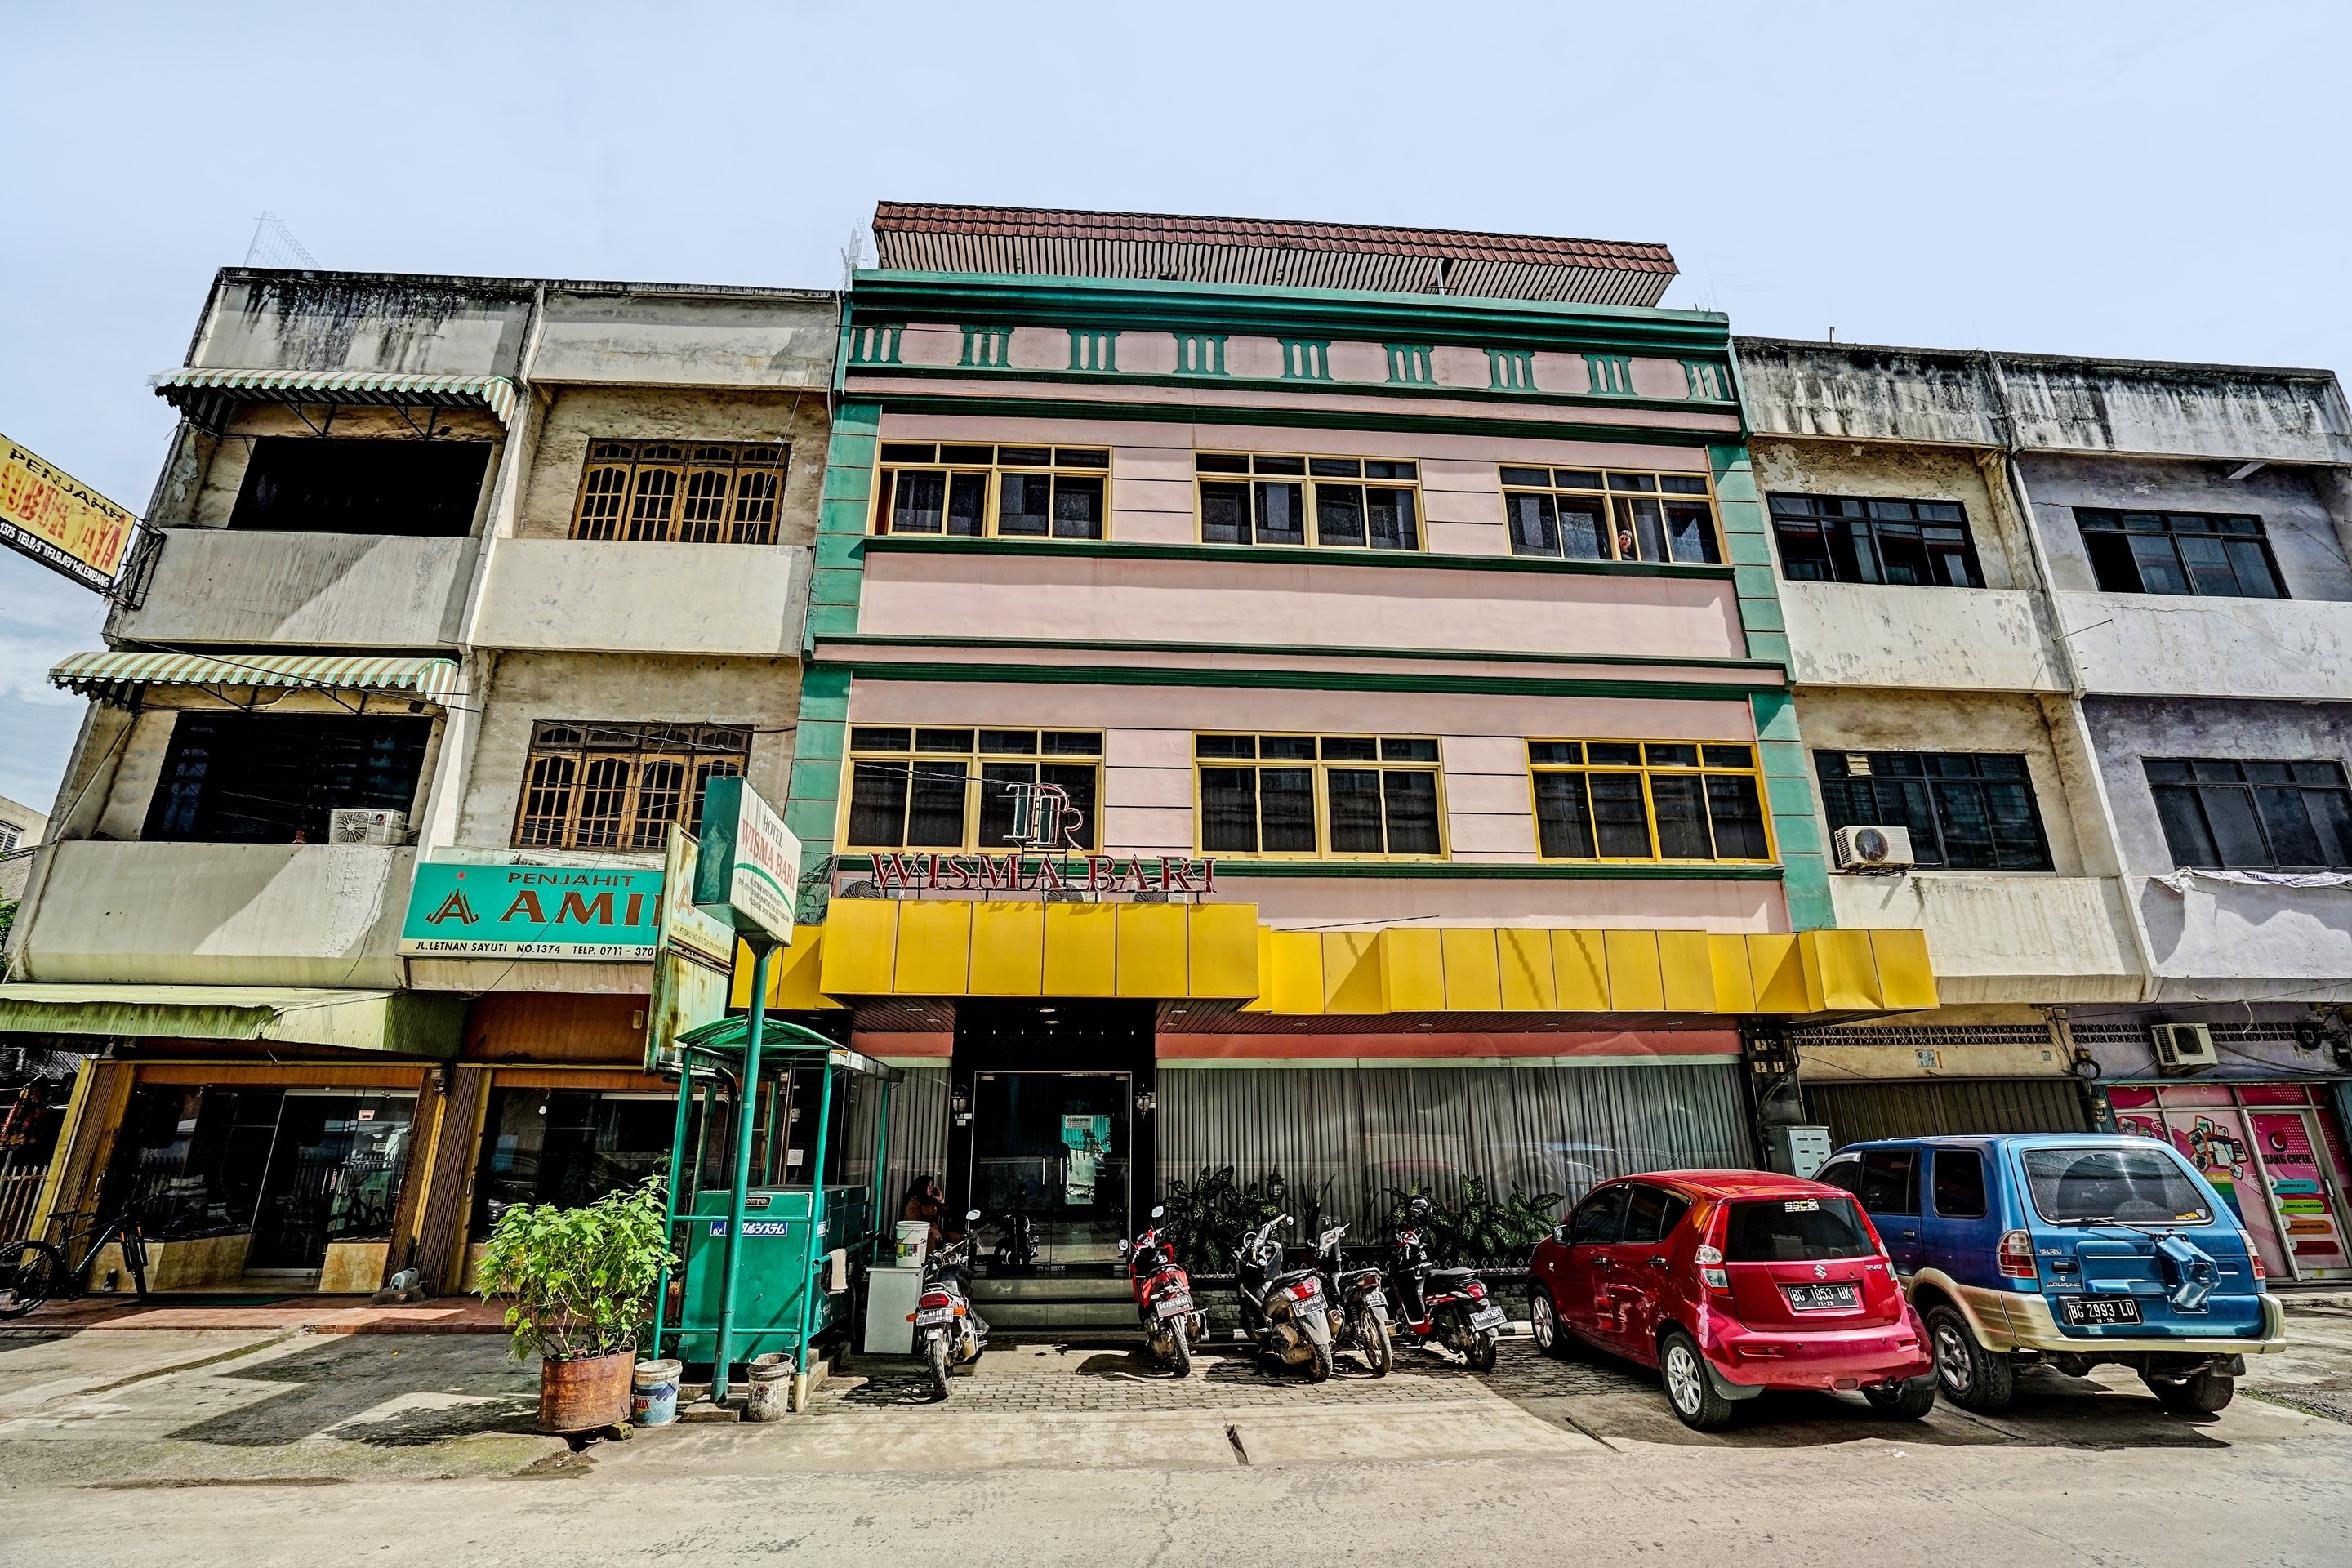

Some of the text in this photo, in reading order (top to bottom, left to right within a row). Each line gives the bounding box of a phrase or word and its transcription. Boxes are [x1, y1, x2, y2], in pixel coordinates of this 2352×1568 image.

[763, 814, 783, 849] HOTEL
[742, 818, 797, 891] WISMA BARI
[507, 872, 635, 887] PENJAHIT
[867, 851, 1218, 894] WISMA BARI
[497, 889, 662, 927] AMI
[471, 942, 507, 953] SAYUTI
[572, 945, 596, 955] TELP.
[2262, 1154, 2312, 1164] UANG CIPTA
[1790, 1286, 1852, 1302] BG 1853 UK
[2069, 1302, 2135, 1319] BG 2993 LD
